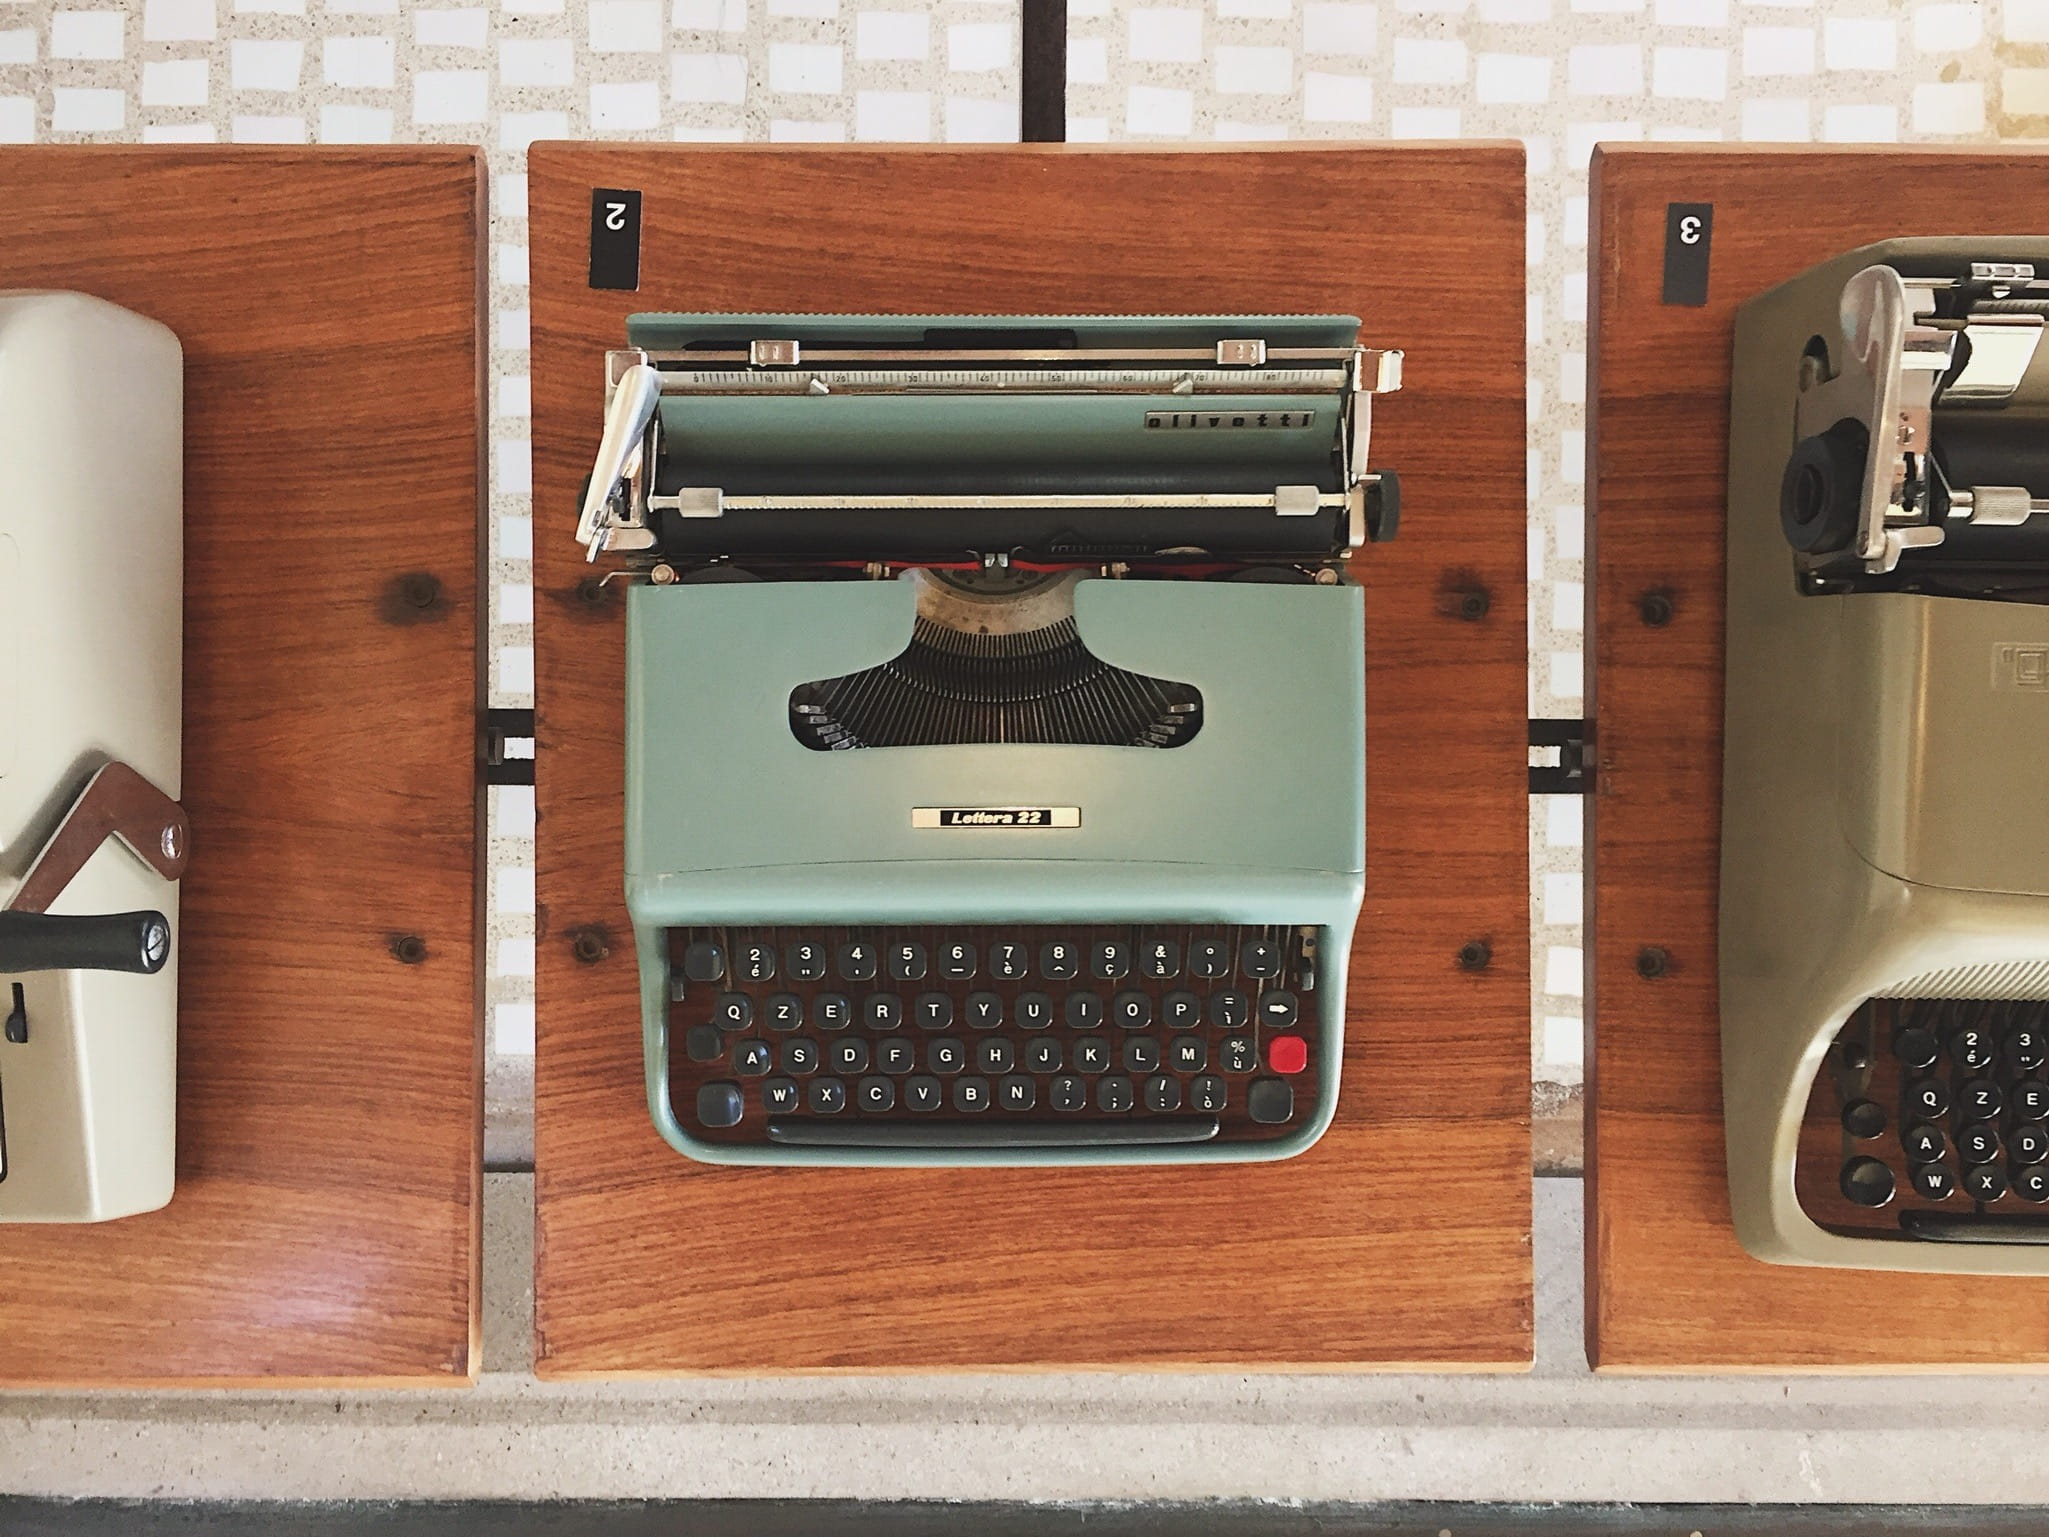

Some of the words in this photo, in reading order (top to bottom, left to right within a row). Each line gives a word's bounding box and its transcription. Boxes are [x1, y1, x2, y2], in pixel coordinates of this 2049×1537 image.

[605, 202, 627, 231] 2
[1680, 215, 1702, 245] 3
[836, 375, 846, 383] 20
[979, 375, 990, 383] 40
[1147, 413, 1310, 428] olivetti
[950, 811, 1014, 825] Lettera
[1016, 811, 1042, 825] 22
[749, 948, 760, 961] 2
[800, 946, 812, 960] 3
[851, 947, 863, 960] 4
[902, 947, 913, 960] 5
[952, 946, 963, 959] 6
[1003, 946, 1014, 959] 7
[1053, 946, 1064, 959] 8
[1104, 946, 1116, 959] 9
[1155, 945, 1167, 958] &
[751, 964, 760, 977] é
[1003, 961, 1013, 974] è
[1105, 964, 1114, 975] ç
[1156, 961, 1165, 974] à
[727, 1005, 741, 1020] Q
[777, 1005, 789, 1019] Z
[826, 1004, 837, 1018] E
[876, 1004, 888, 1018] R
[927, 1003, 940, 1017] T
[978, 1003, 989, 1017] Y
[1028, 1004, 1039, 1018] U
[1081, 1003, 1086, 1016] I
[1126, 1003, 1139, 1017] O
[1176, 1003, 1187, 1016] P
[1230, 1040, 1246, 1053] %
[1966, 1032, 1978, 1046] 2
[2019, 1033, 2031, 1046] 3
[746, 1051, 758, 1065] A
[794, 1049, 805, 1063] S
[844, 1048, 856, 1062] D
[890, 1049, 901, 1062] F
[939, 1048, 952, 1062] G
[990, 1048, 1001, 1062] H
[1039, 1048, 1048, 1062] J
[1085, 1048, 1097, 1062] K
[1135, 1048, 1146, 1061] L
[1181, 1047, 1195, 1061] M
[1233, 1056, 1242, 1069] ù
[1967, 1049, 1976, 1063] é
[1064, 1079, 1072, 1091] ?
[772, 1089, 787, 1102] W
[822, 1088, 832, 1101] X
[870, 1087, 882, 1101] C
[917, 1087, 928, 1100] V
[965, 1087, 977, 1101] B
[1011, 1086, 1023, 1099] N
[1923, 1091, 1937, 1107] Q
[1976, 1091, 1988, 1105] Z
[2027, 1092, 2038, 1106] E
[1920, 1137, 1932, 1150] A
[1973, 1136, 1985, 1150] S
[2023, 1137, 2035, 1151] D
[1927, 1175, 1942, 1188] W
[1981, 1176, 1992, 1189] X
[2030, 1176, 2042, 1190] C
